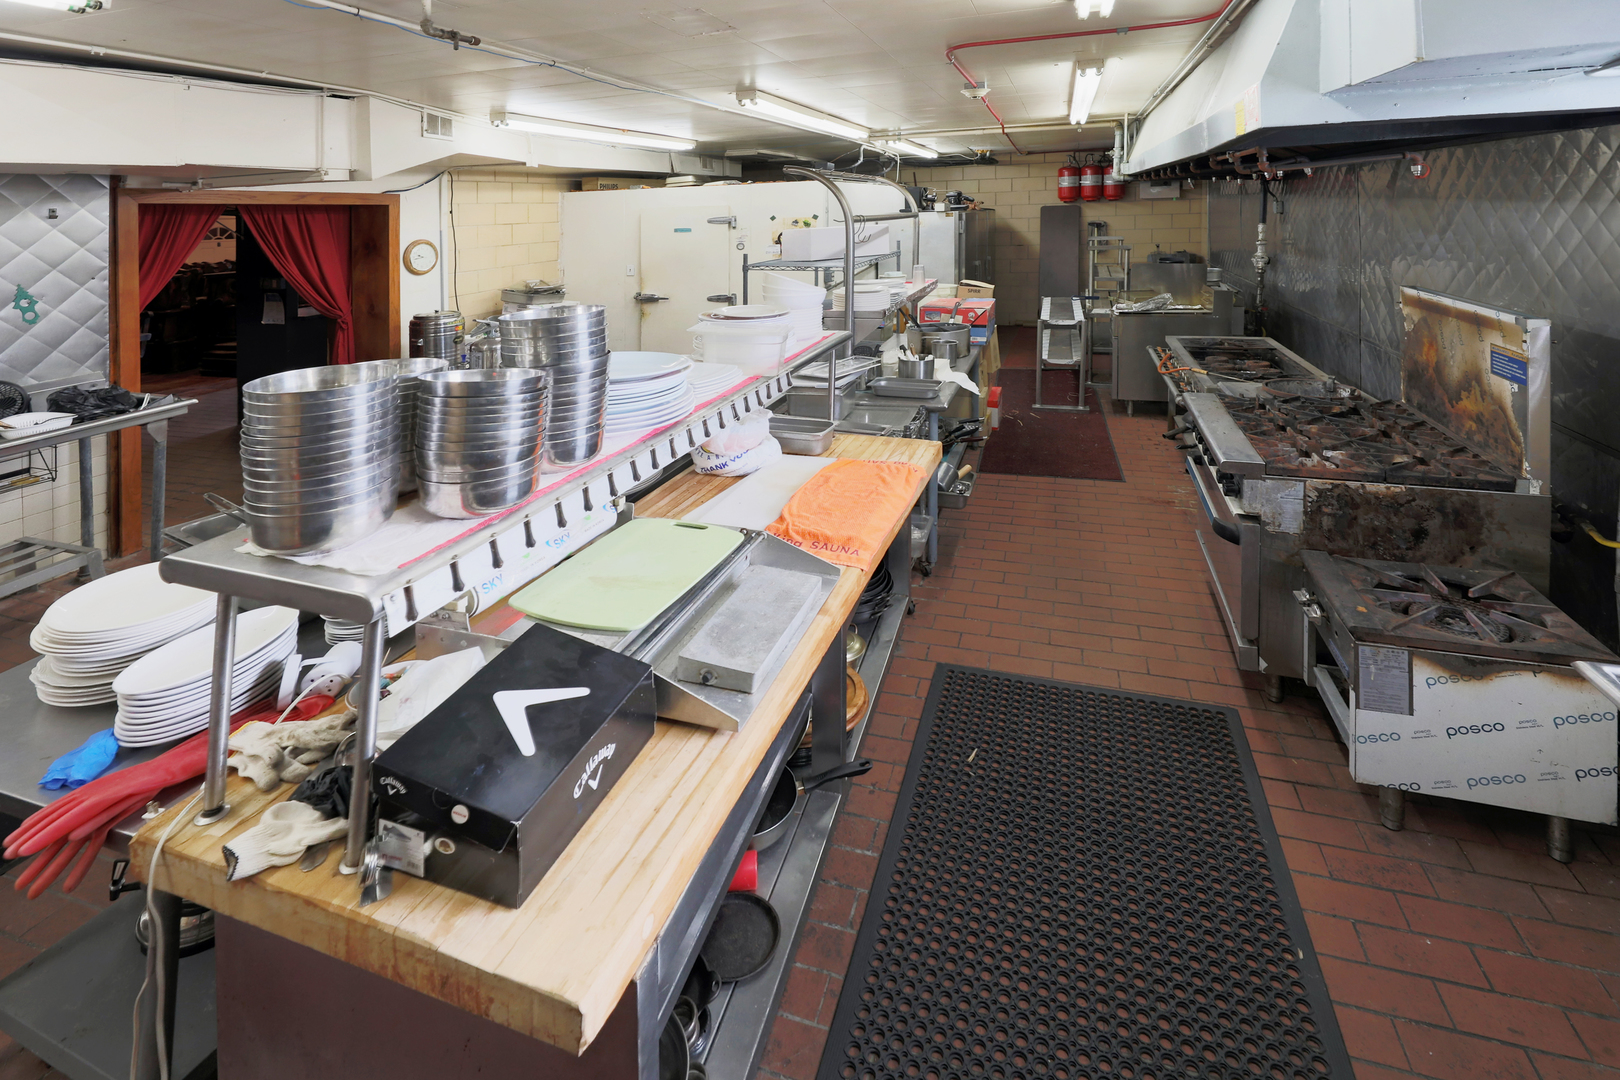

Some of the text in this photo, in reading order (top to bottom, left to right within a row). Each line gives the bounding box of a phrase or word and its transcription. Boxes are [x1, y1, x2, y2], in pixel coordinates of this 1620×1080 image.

[553, 532, 571, 549] SKY
[809, 541, 860, 557] SAUNA
[481, 573, 504, 595] SKY
[1553, 711, 1616, 729] posco
[1354, 732, 1401, 744] osco
[1446, 723, 1505, 740] posco
[573, 743, 616, 799] Callaway
[1466, 774, 1526, 790] posco
